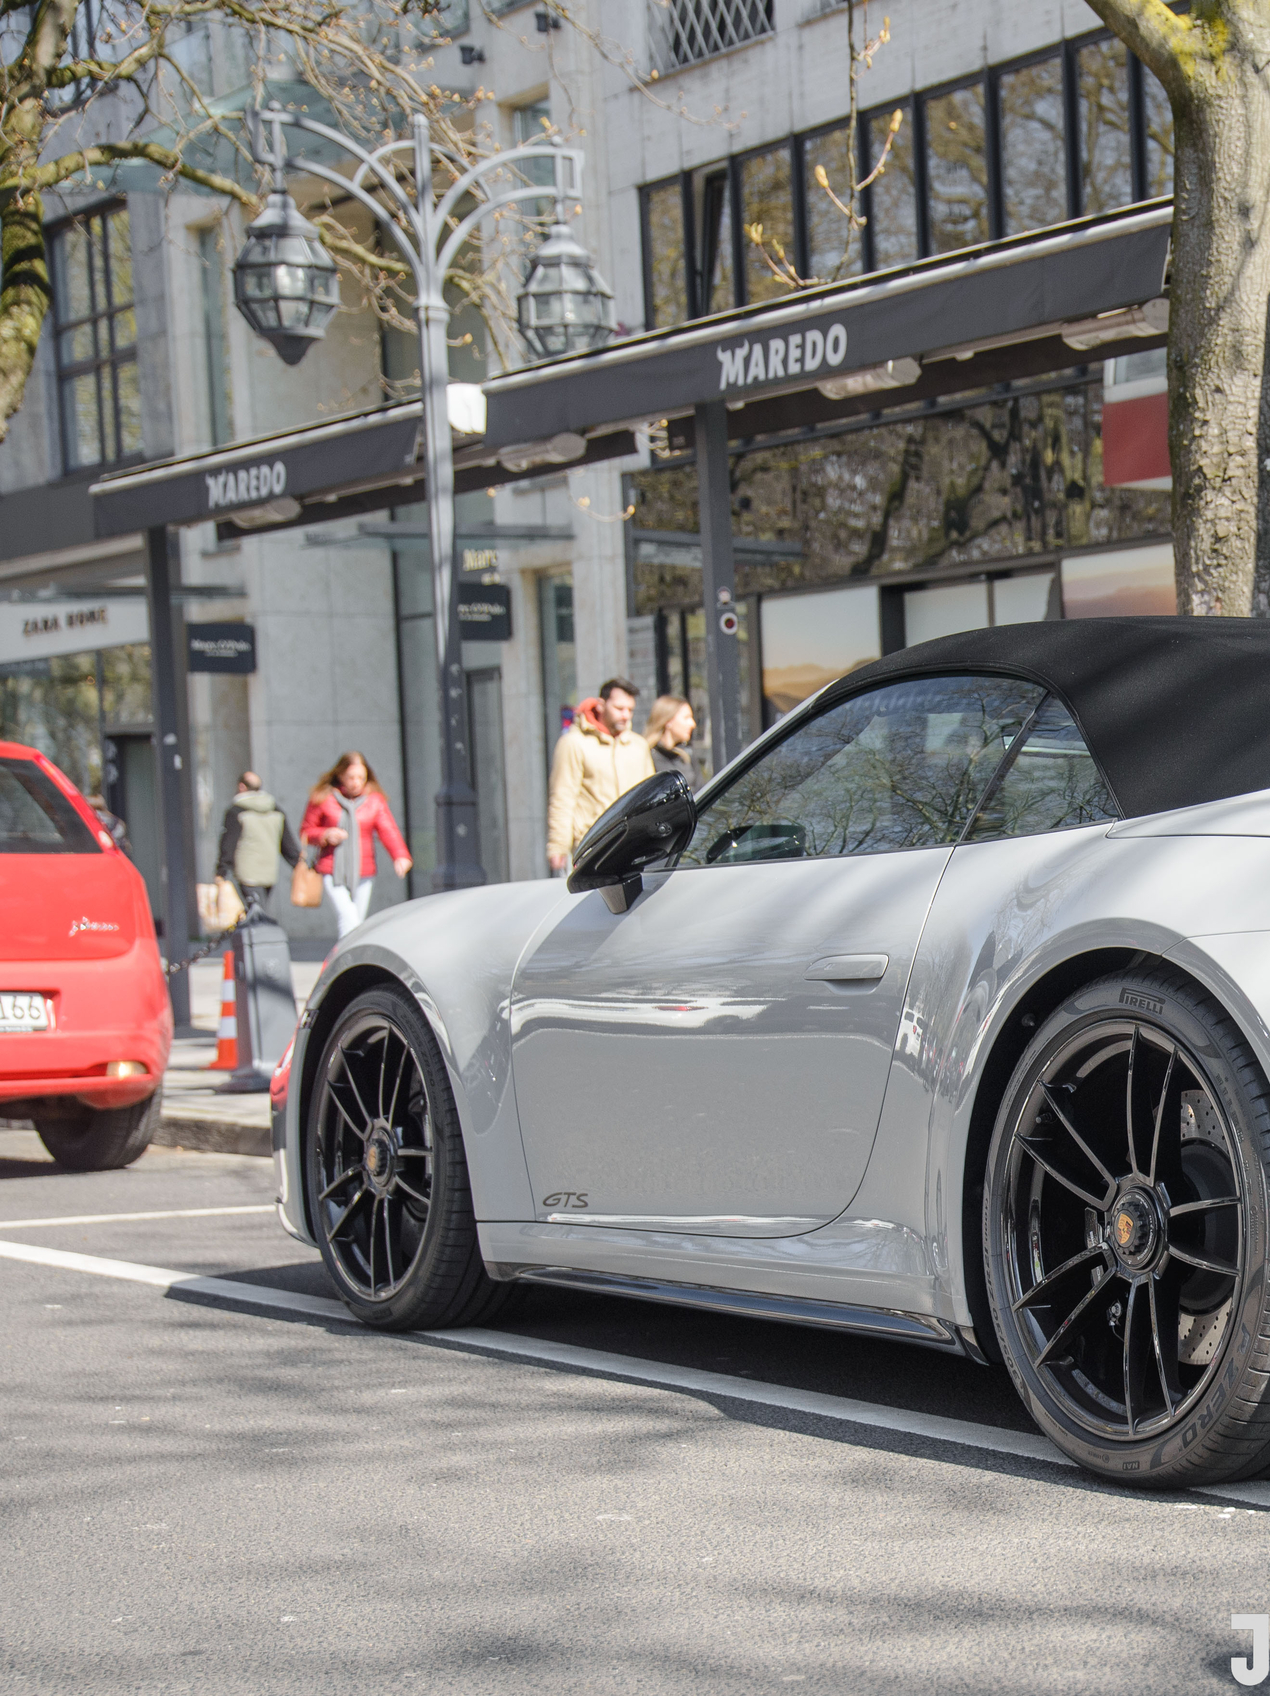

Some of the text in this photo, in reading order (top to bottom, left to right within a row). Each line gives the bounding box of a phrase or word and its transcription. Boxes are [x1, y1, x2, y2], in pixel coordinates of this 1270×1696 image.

[716, 323, 848, 391] MAREDO
[205, 461, 287, 509] MAREDO
[1119, 987, 1166, 1016] PIRELLI
[543, 1192, 588, 1208] GTS
[1182, 1357, 1239, 1449] ZERO
